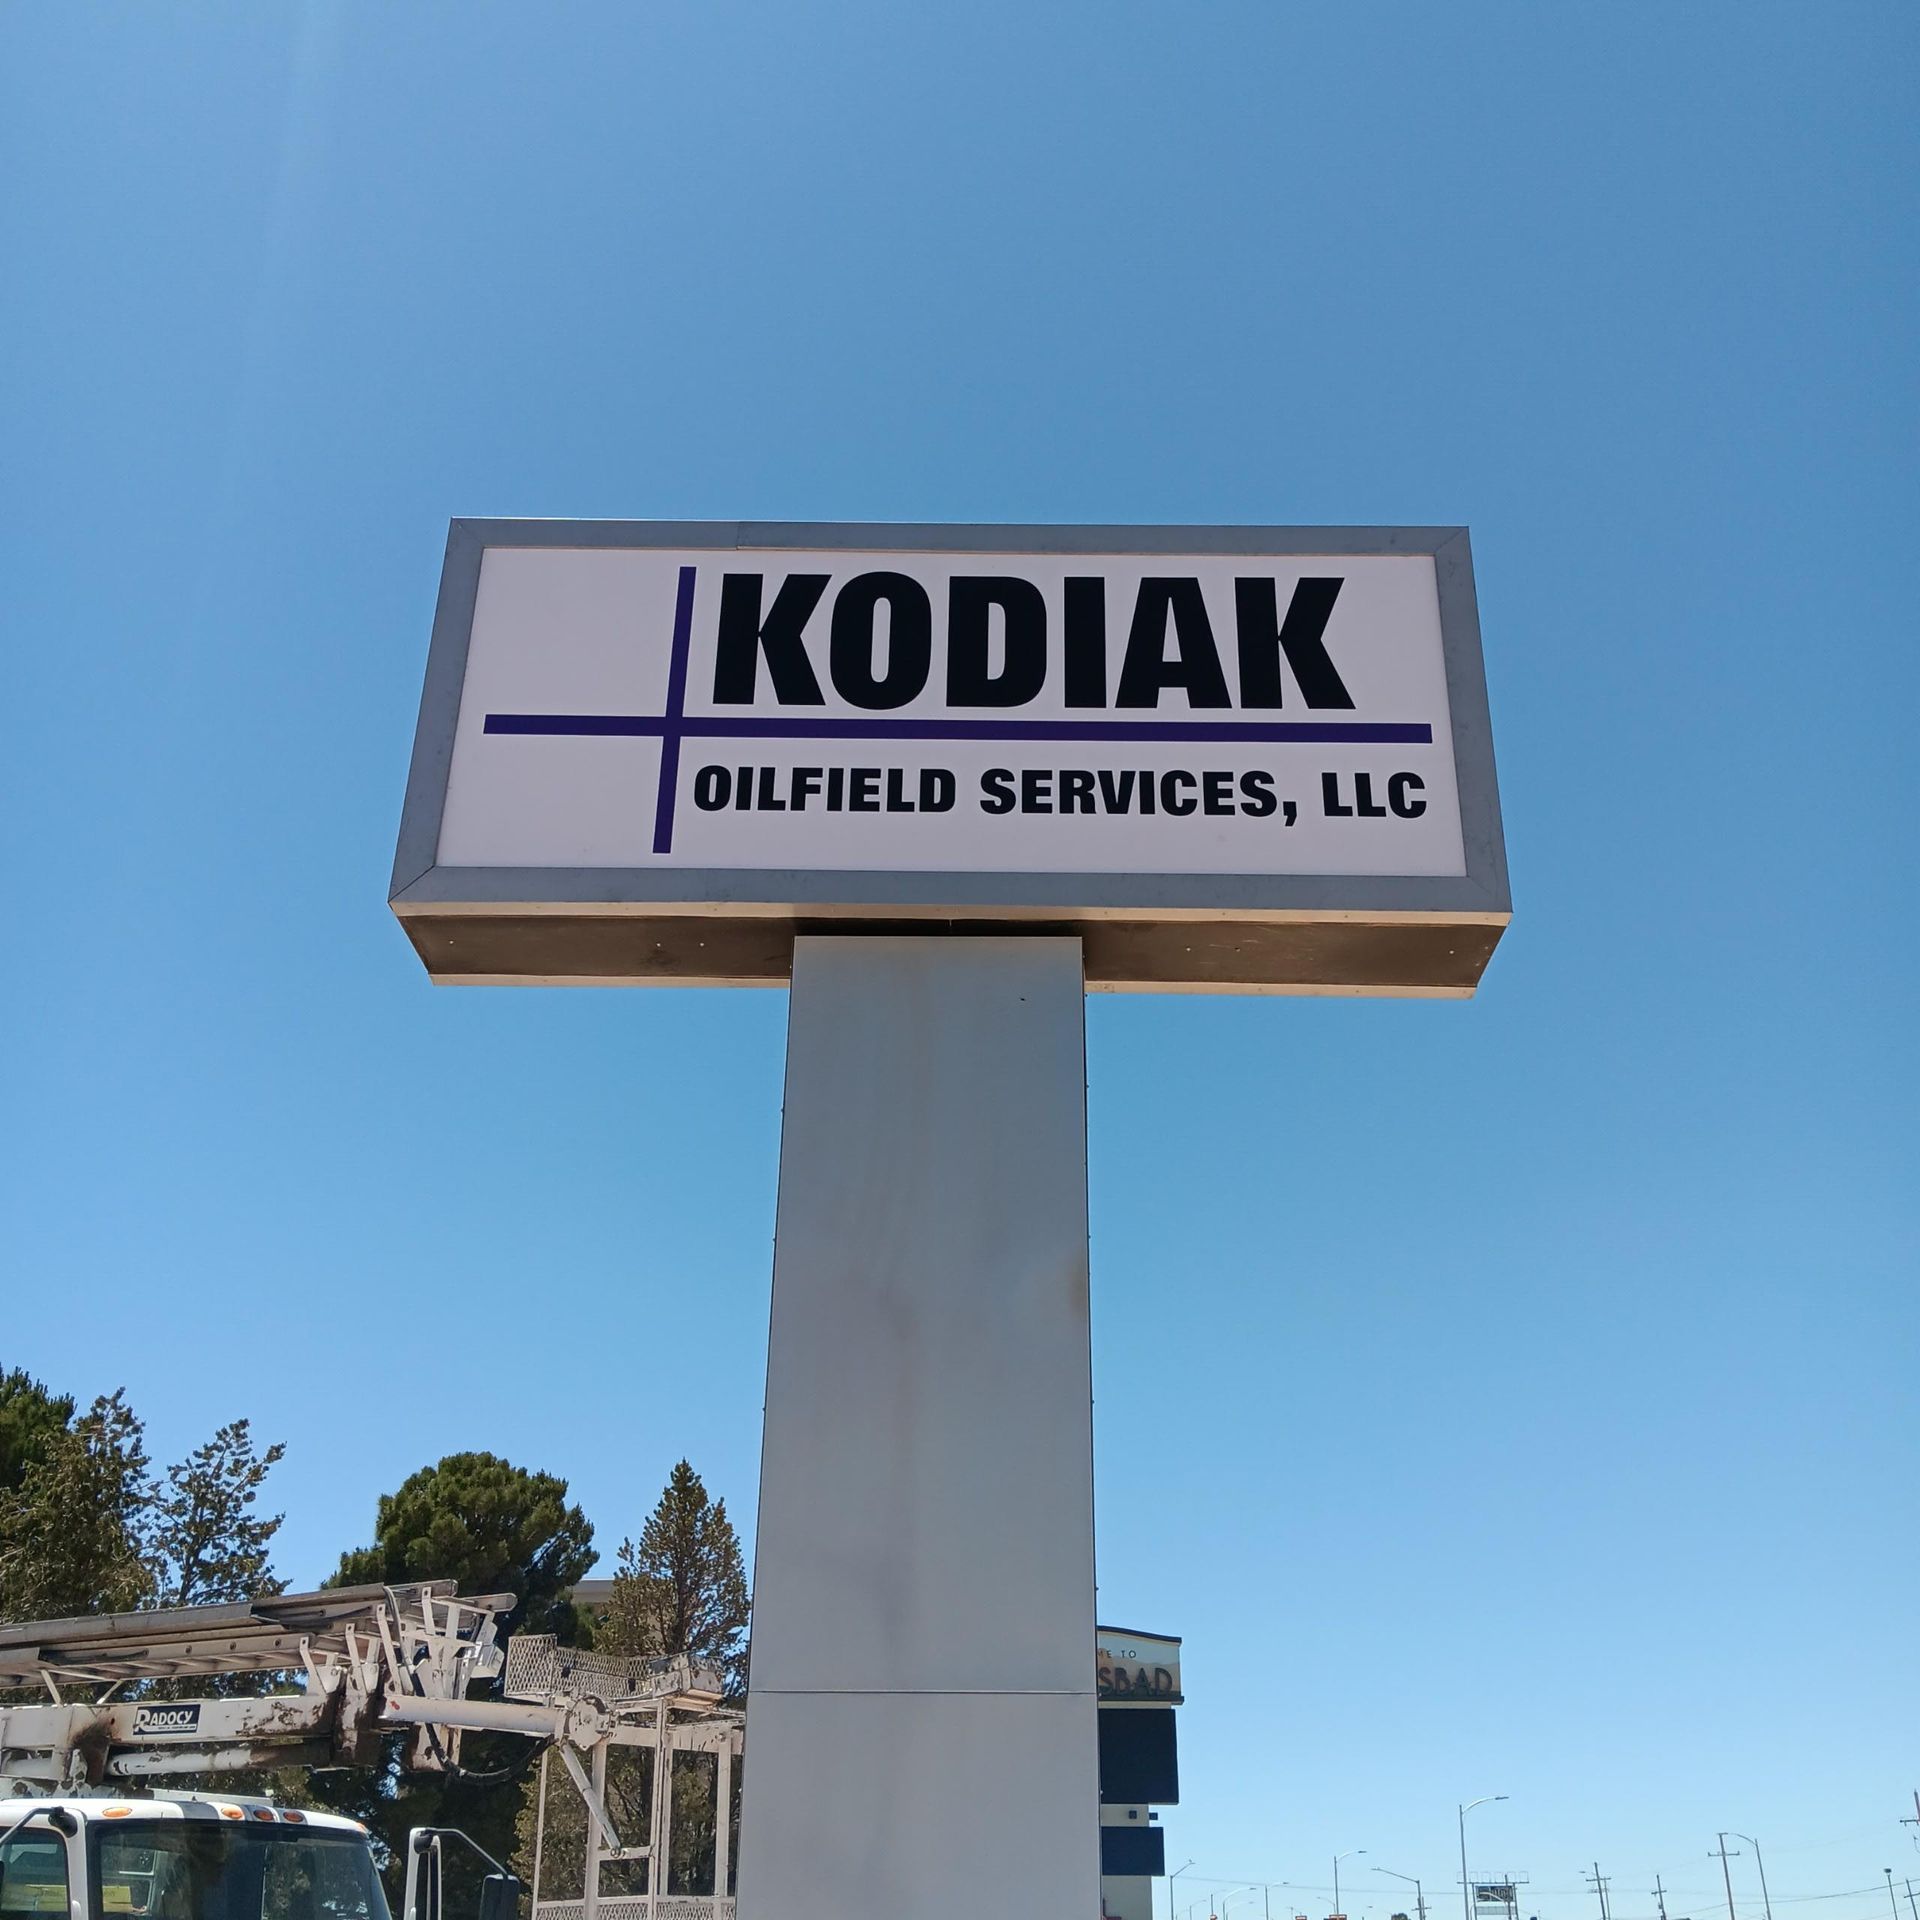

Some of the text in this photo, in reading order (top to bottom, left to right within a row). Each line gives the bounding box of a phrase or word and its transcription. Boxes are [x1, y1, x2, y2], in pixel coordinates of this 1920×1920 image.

[713, 571, 1357, 711] KODIAK
[694, 765, 1428, 827] OILFIELD SERVICES, LLC
[1120, 1649, 1137, 1659] TO
